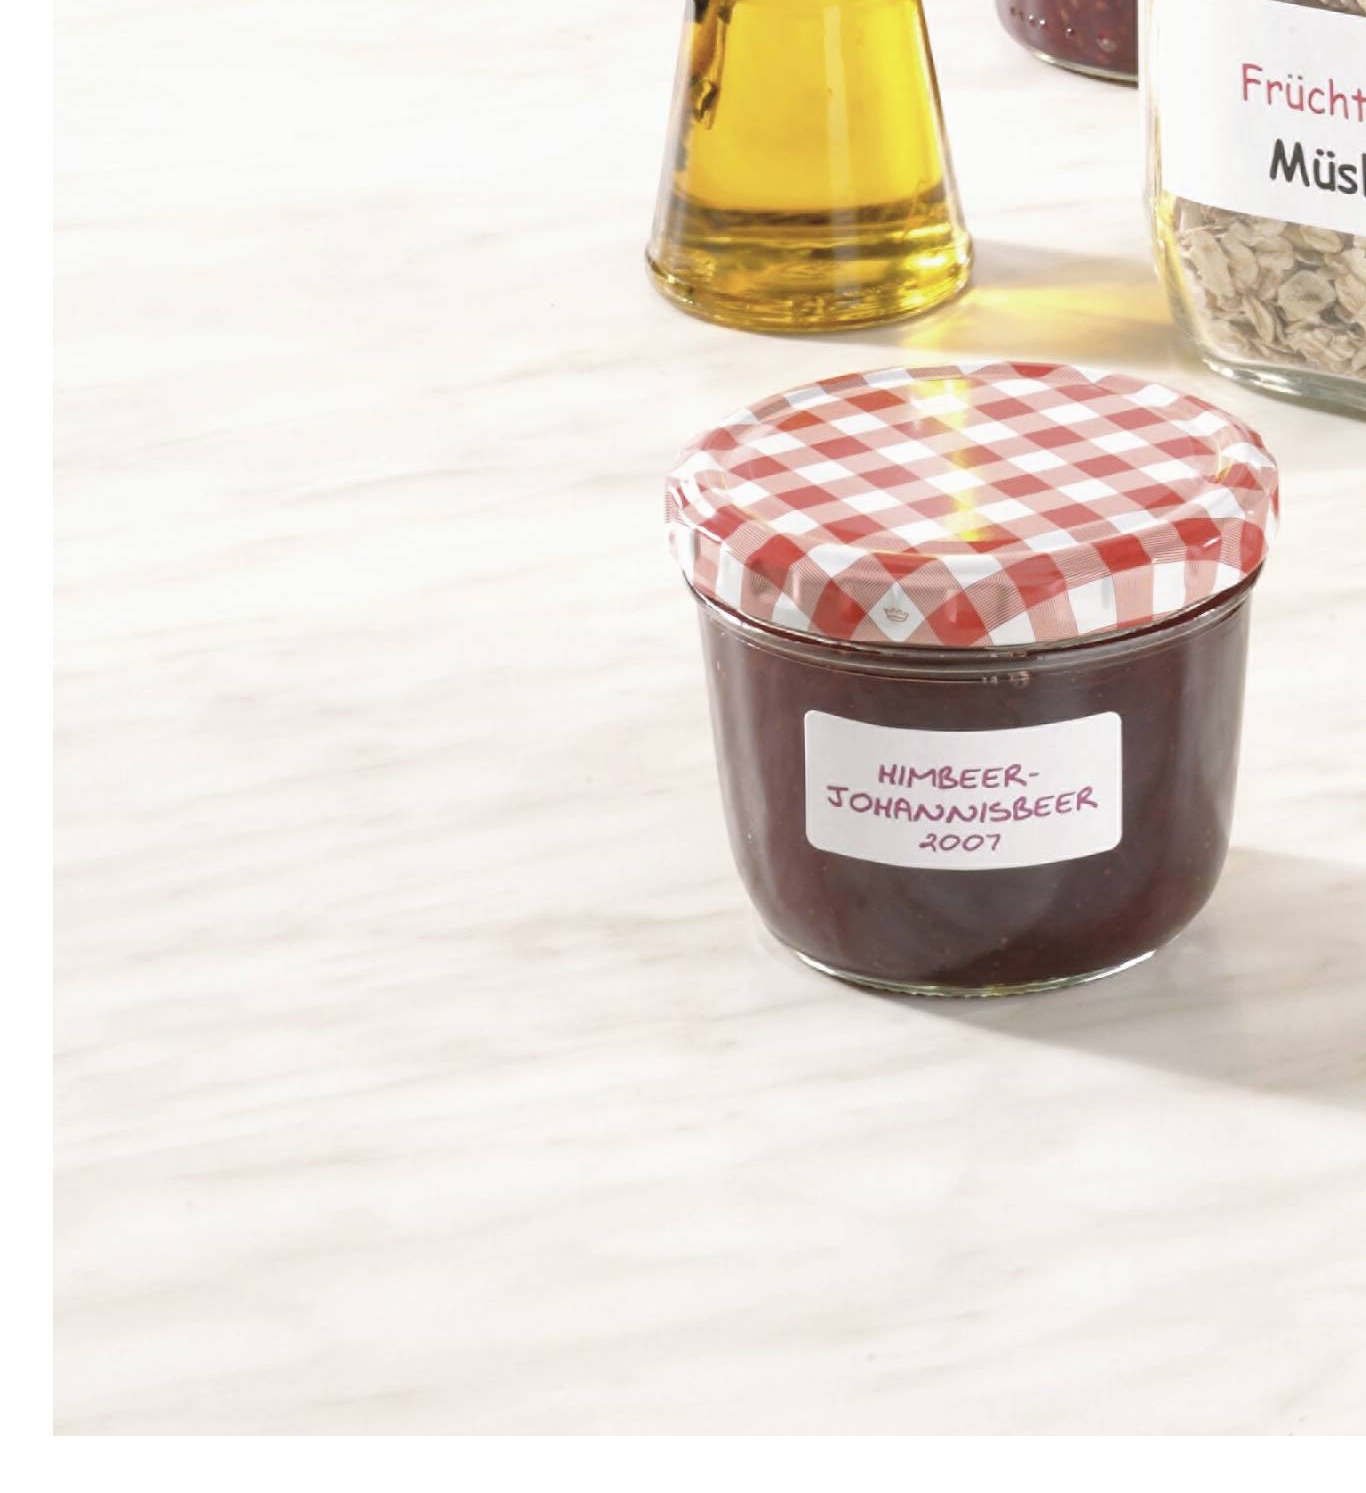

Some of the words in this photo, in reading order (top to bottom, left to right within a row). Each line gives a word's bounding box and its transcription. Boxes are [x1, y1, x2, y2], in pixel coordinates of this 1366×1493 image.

[878, 763, 1040, 789] HIMBEER-
[826, 786, 1099, 823] JOHANNISBEER
[918, 833, 1001, 852] 2007
